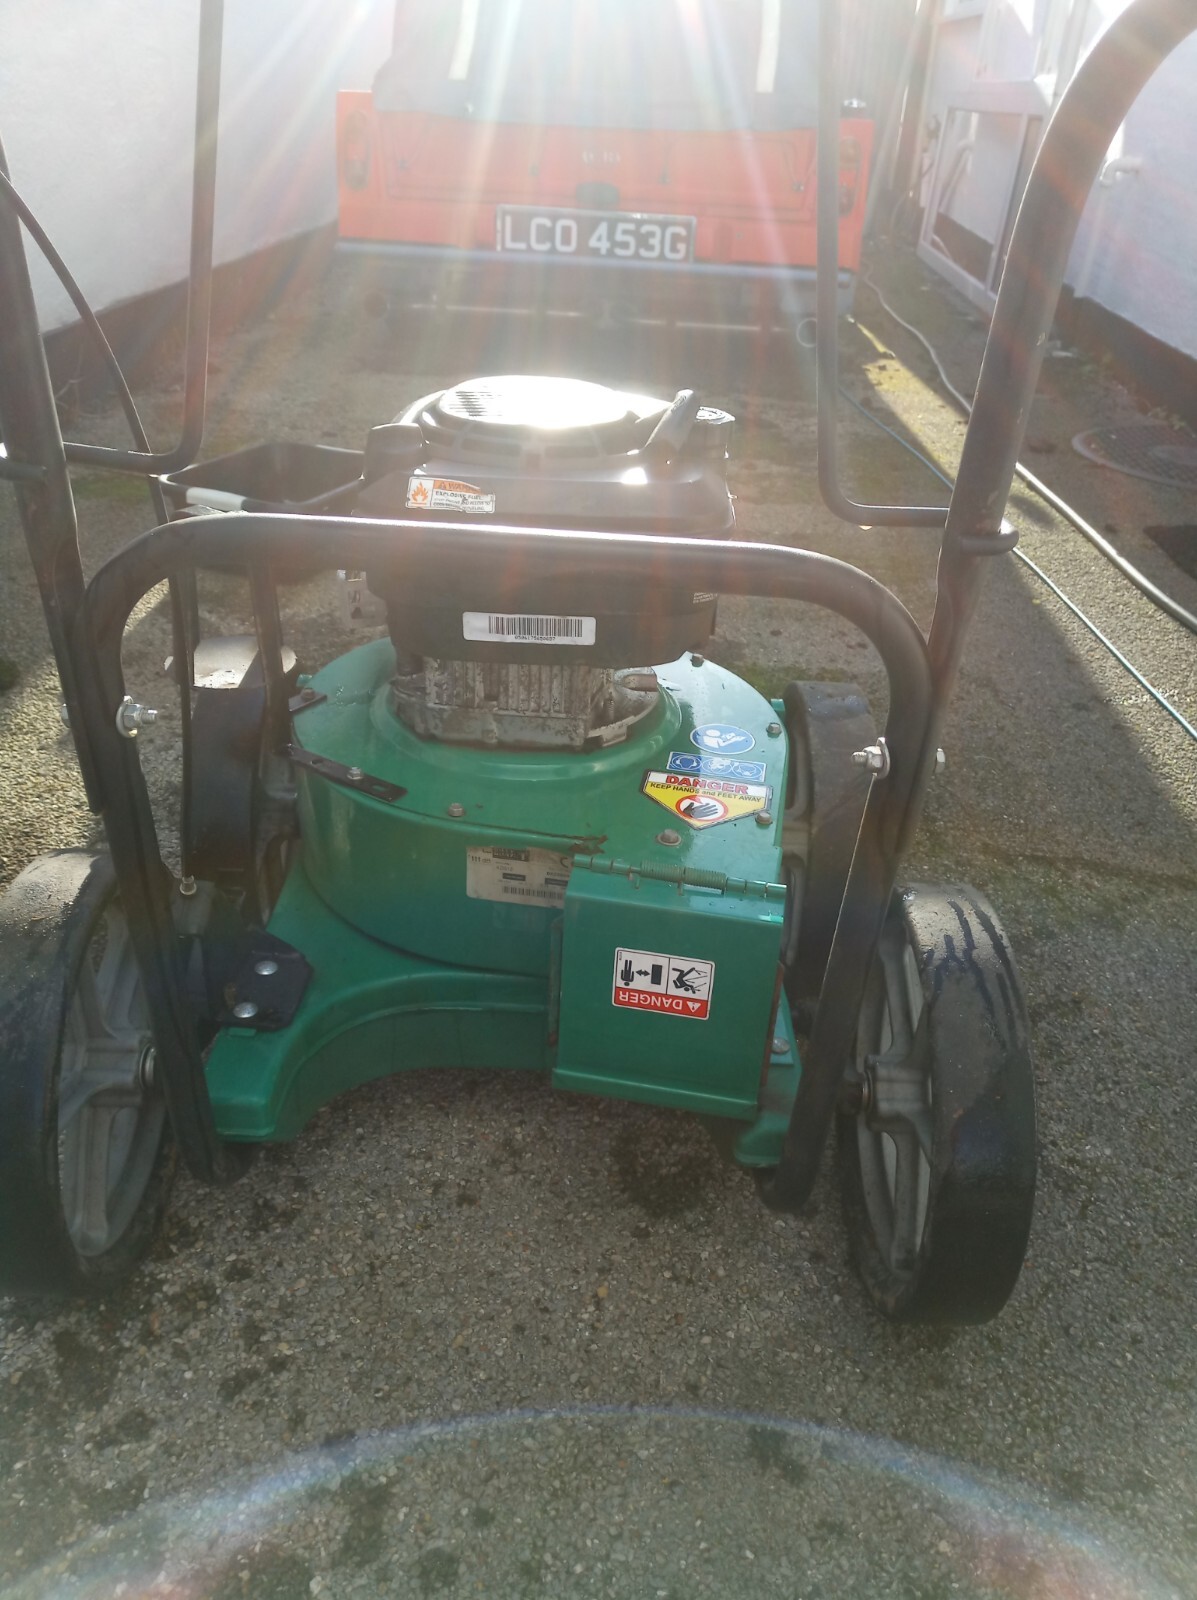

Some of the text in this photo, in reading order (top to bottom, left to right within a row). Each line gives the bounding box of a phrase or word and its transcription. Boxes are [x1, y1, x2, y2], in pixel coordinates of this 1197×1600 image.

[504, 214, 688, 260] LCO 453G
[650, 782, 672, 790] KEEP
[672, 784, 700, 794] HANDS
[738, 794, 762, 802] AWAY
[665, 775, 749, 795] DANGER
[618, 990, 683, 1010] DANGER
